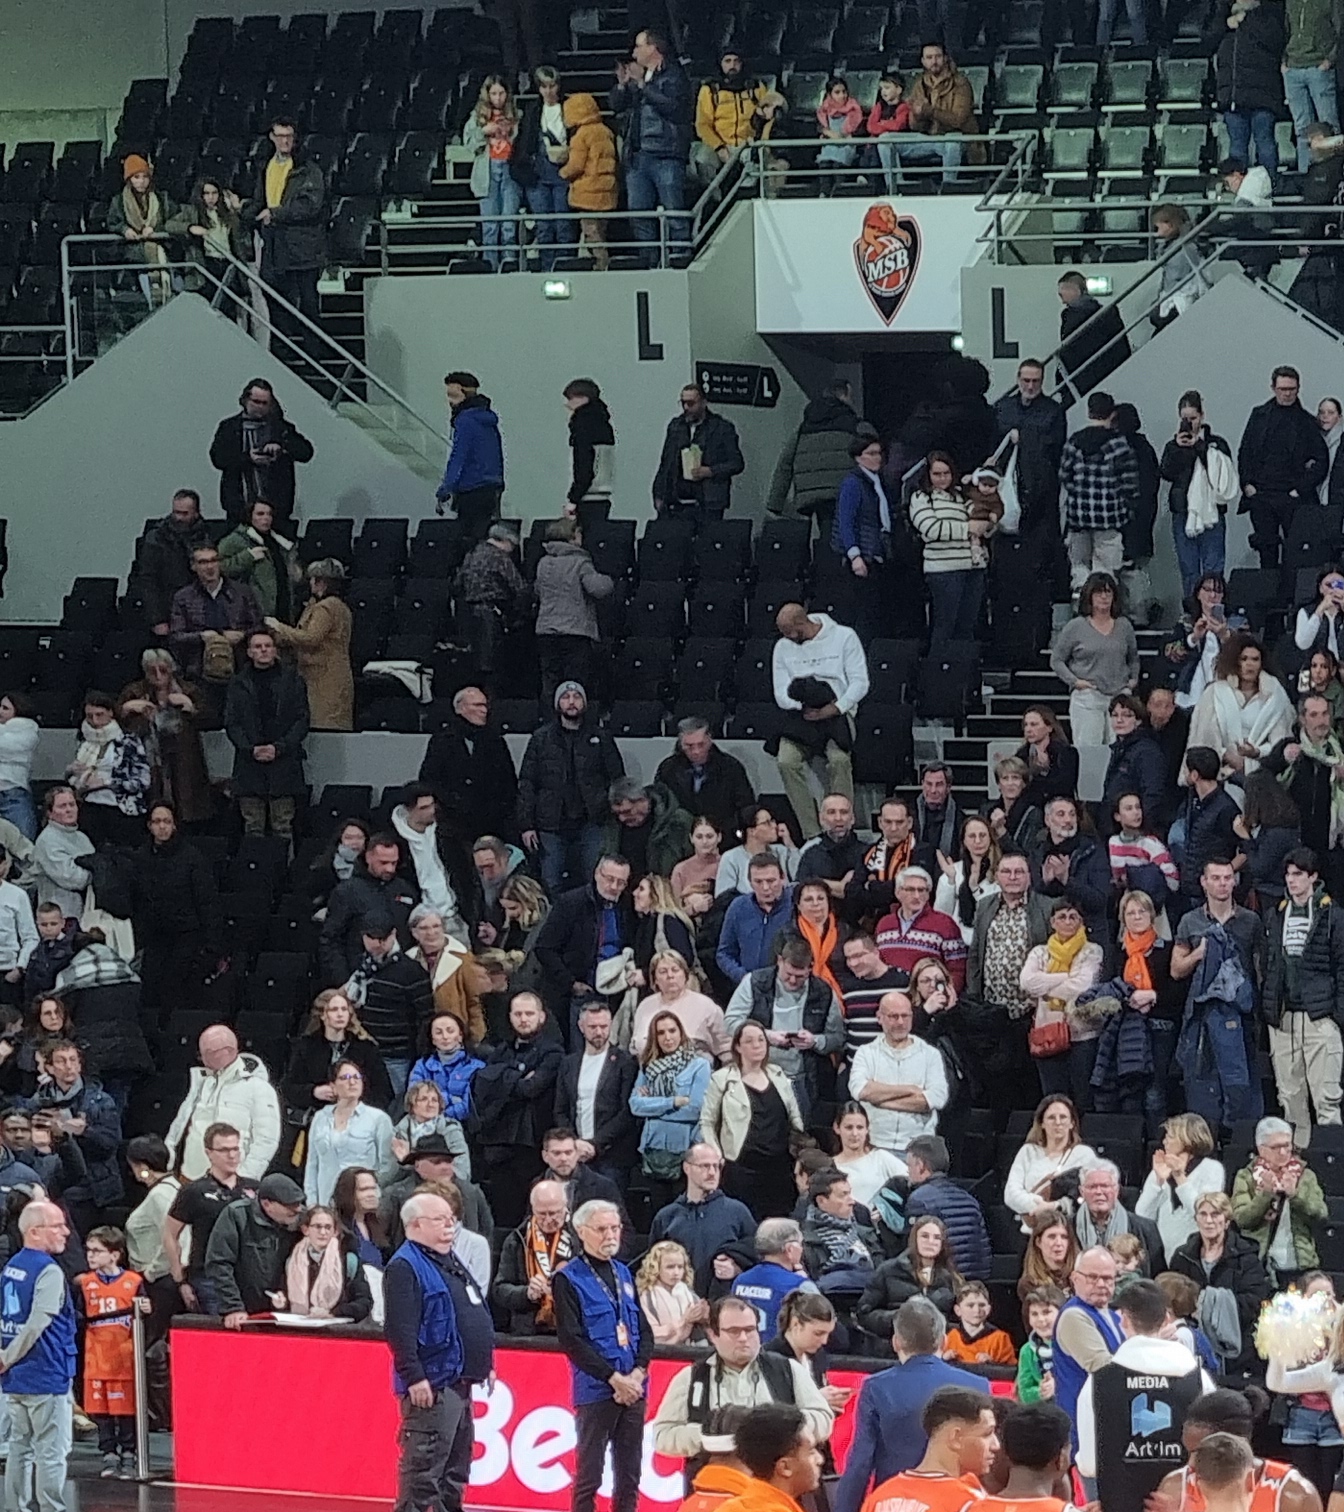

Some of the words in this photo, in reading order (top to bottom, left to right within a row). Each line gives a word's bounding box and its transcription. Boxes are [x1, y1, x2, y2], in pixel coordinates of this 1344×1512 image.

[867, 248, 910, 282] MSB
[637, 291, 664, 360] L
[991, 287, 1019, 359] L
[763, 376, 773, 397] L
[98, 1297, 118, 1313] 13
[1126, 1376, 1170, 1390] MEDIA
